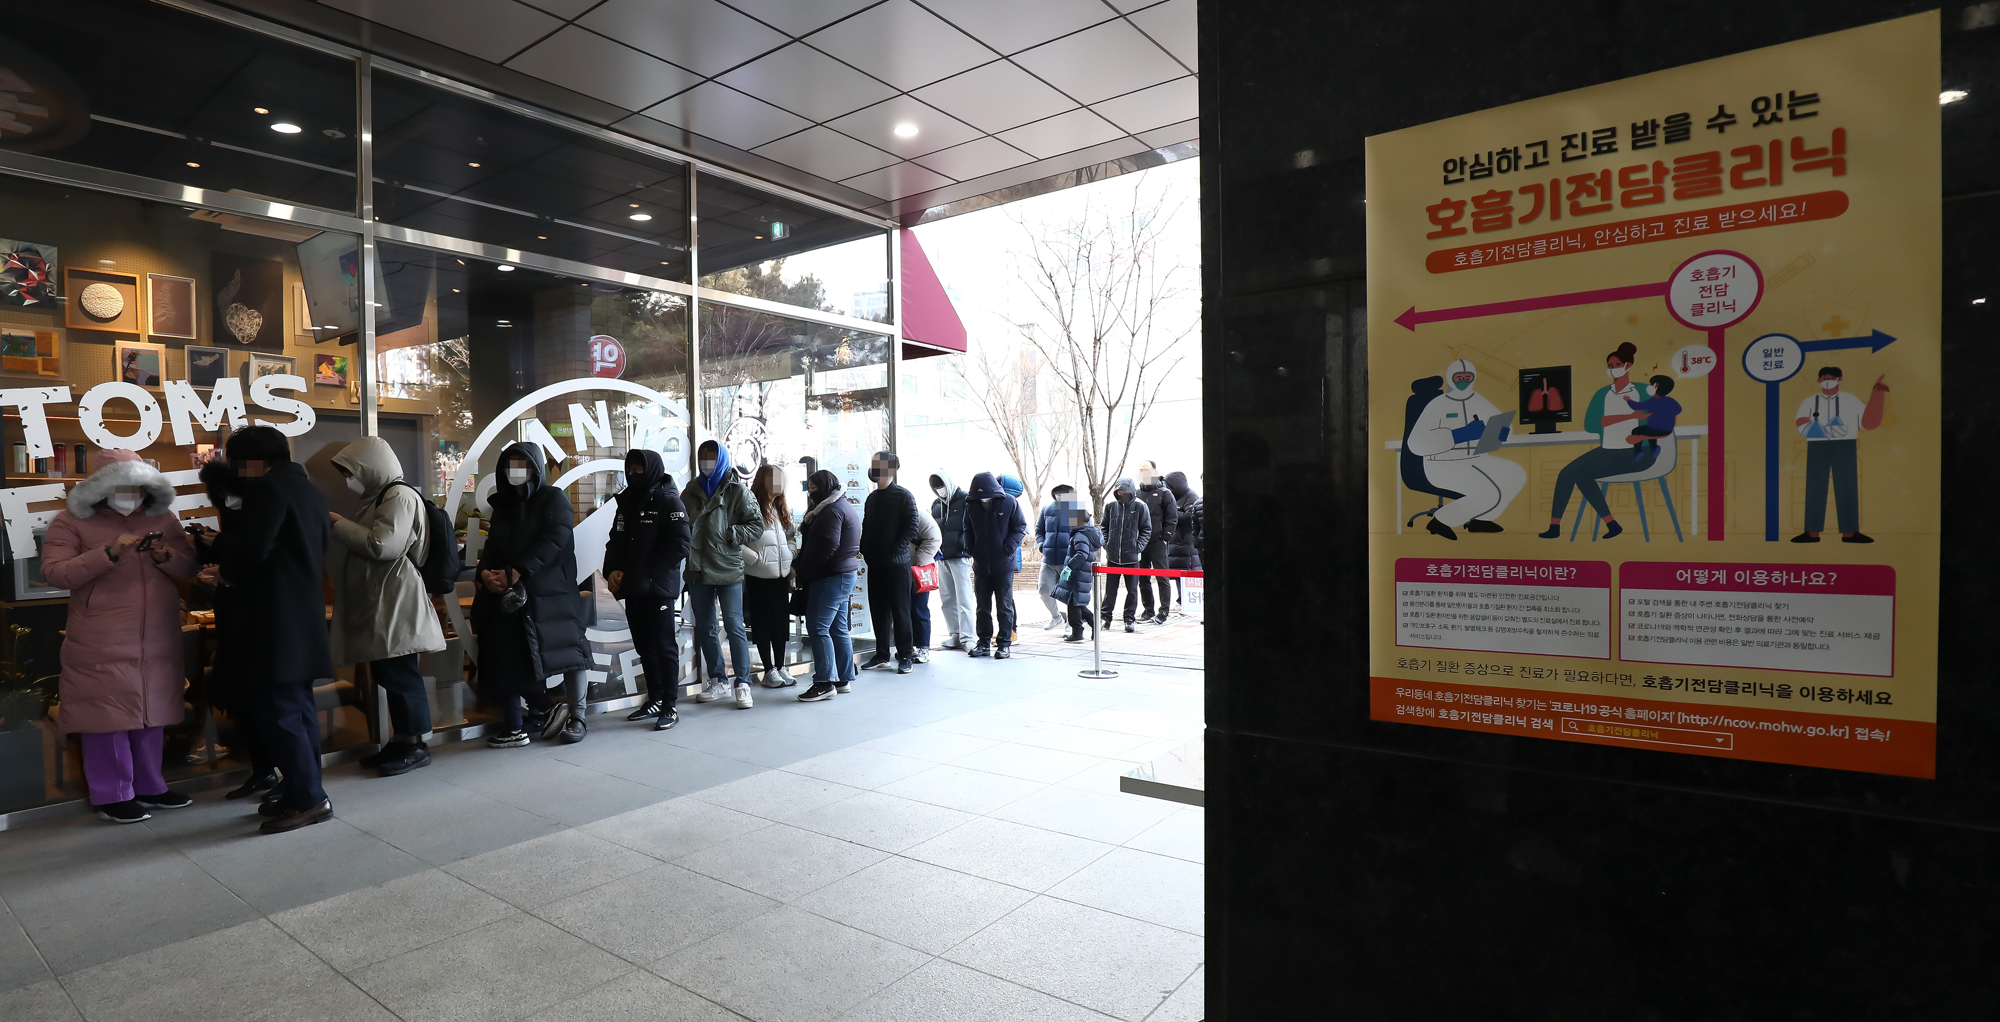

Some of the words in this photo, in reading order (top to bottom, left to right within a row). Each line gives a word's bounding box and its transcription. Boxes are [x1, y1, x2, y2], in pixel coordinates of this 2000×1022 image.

[1443, 140, 1550, 184] 안심하고
[1560, 125, 1619, 162] 진료
[1630, 112, 1692, 150] 받을
[1706, 104, 1737, 134] 수
[1751, 91, 1820, 127] 있는
[1424, 129, 1849, 239] 호흡기전담클리닉
[1454, 234, 1586, 266] 호흡기전담클리닉,
[1594, 222, 1665, 246] 안심하고
[1674, 215, 1710, 234] 진료
[1718, 202, 1806, 228] 받으세요!
[1690, 264, 1737, 282] 호흡기
[1698, 282, 1729, 299] 전담
[1690, 299, 1737, 316] 클리닉
[1762, 346, 1785, 358] 일반
[1762, 359, 1785, 371] 진료
[1426, 564, 1577, 580] 호흡기전담클리닉이란?
[1676, 569, 1727, 585] 어떻게
[1734, 570, 1837, 586] 이용하나요?
[1397, 657, 1431, 671] 호흡기
[1436, 660, 1460, 674] 질환
[1464, 662, 1514, 676] 증상으로
[1519, 666, 1558, 681] 진료가
[1563, 669, 1636, 687] 필요하다면,
[1641, 675, 1793, 699] 호흡기전담클리닉을
[1799, 686, 1893, 705] 이용하세요
[1395, 687, 1433, 700] 우리동네
[1434, 691, 1513, 707] 호흡기전담클리닉
[1515, 697, 1548, 711] 찾기는
[1598, 705, 1622, 718] 공식
[1677, 712, 1850, 738] [http://ncov.mohw.go.kr]
[1854, 727, 1891, 742] 접속!
[1396, 704, 1435, 718] 검색창에
[1438, 708, 1527, 727] 호흡기전담클리닉
[1530, 717, 1554, 730] 검색
[1587, 724, 1659, 739] 호흡기전담클리닉
